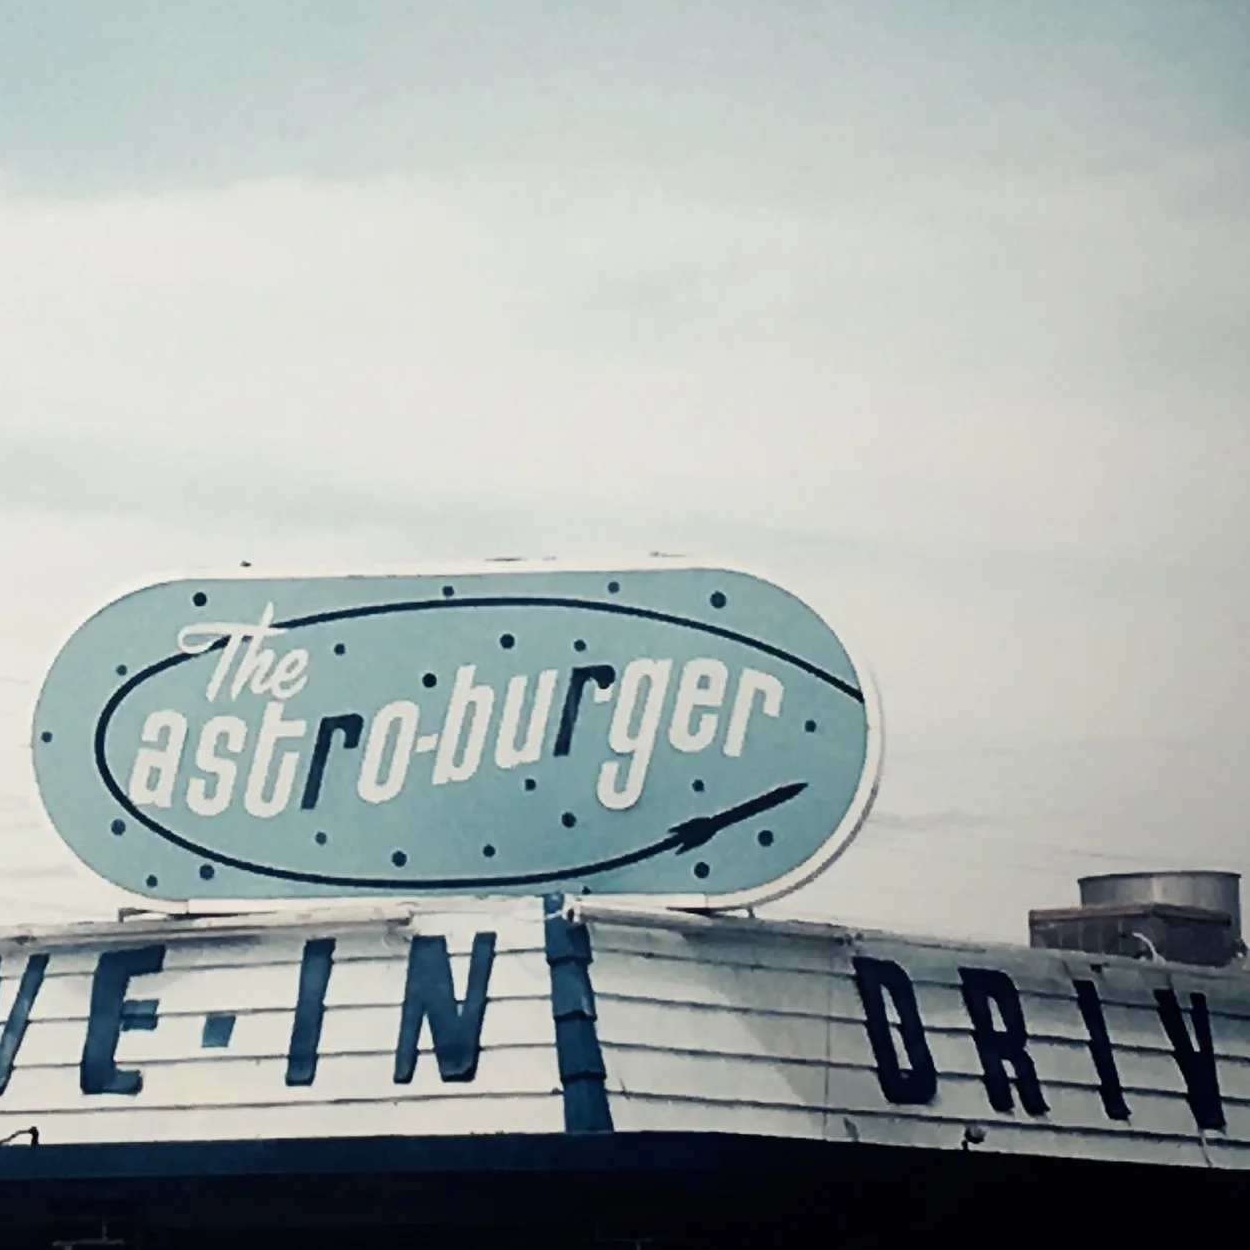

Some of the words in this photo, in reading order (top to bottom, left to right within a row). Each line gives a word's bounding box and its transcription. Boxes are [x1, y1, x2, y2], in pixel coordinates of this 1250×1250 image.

[177, 602, 309, 702] The
[129, 657, 783, 818] astro-burger
[854, 957, 1227, 1130] DRIV
